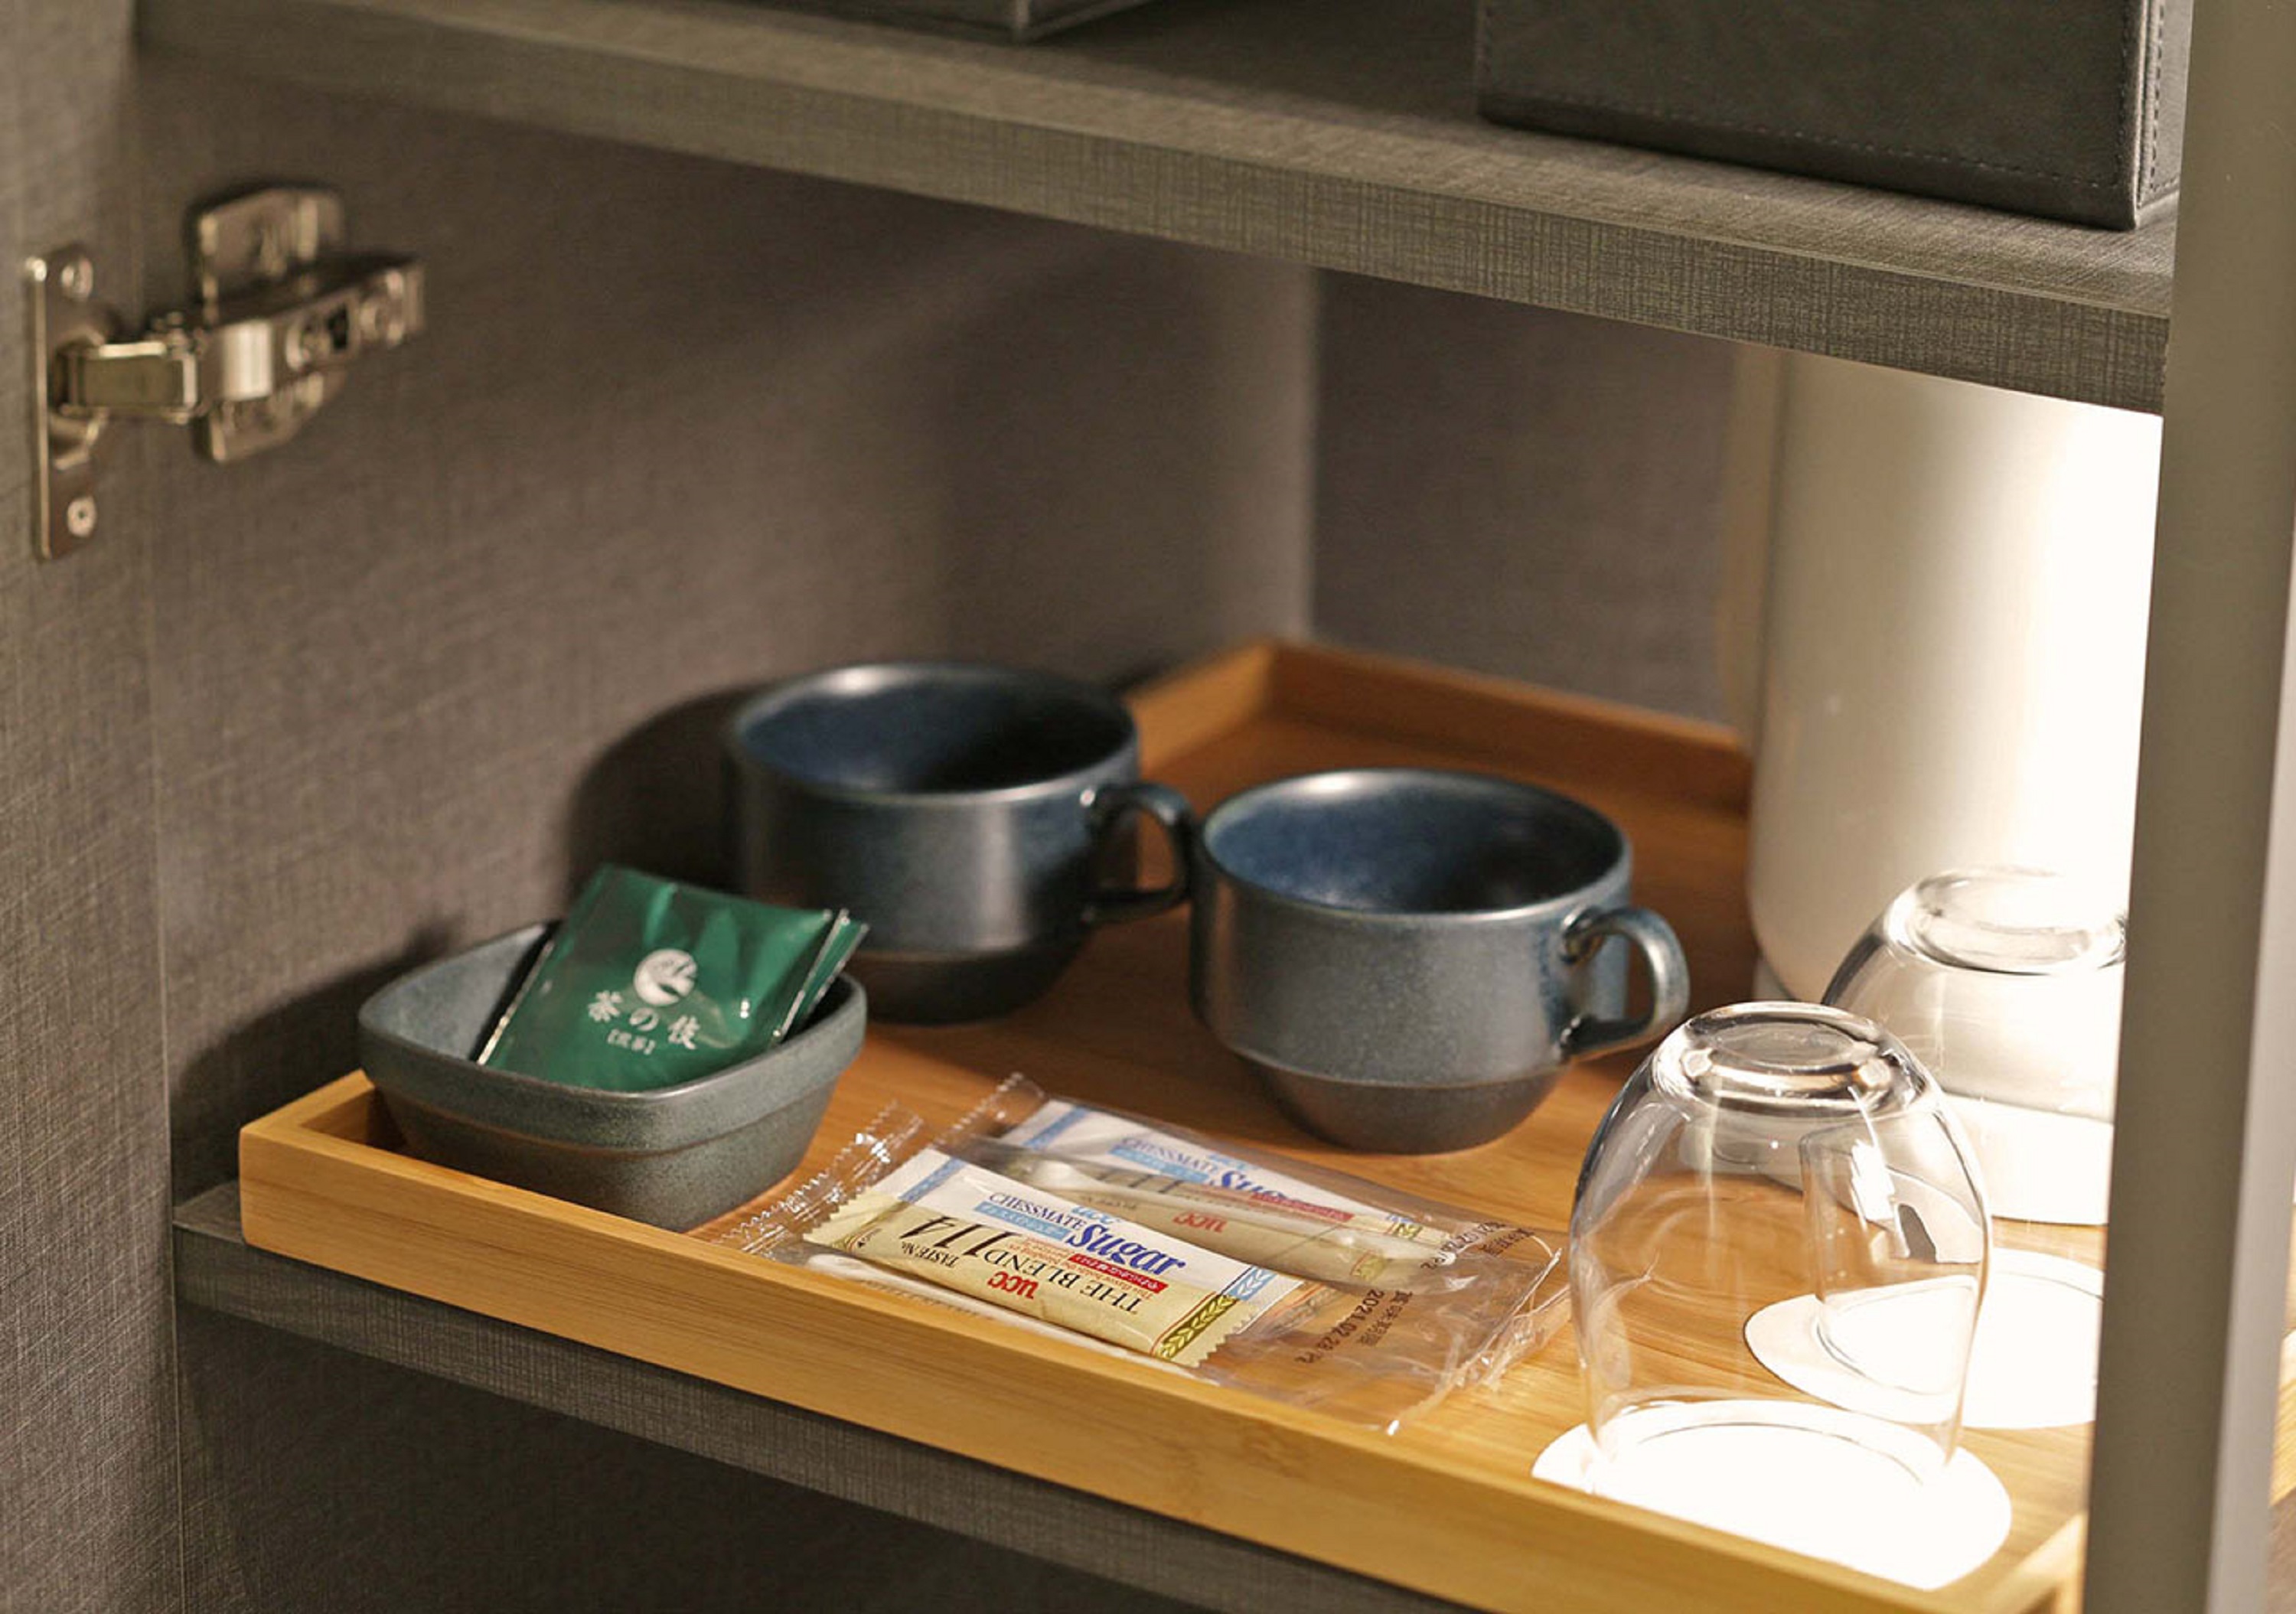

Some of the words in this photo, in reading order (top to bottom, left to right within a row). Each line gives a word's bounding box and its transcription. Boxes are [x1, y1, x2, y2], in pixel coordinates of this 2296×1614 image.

[899, 1216, 1024, 1257] 114
[989, 1192, 1088, 1231] CHESSMATE
[1065, 1224, 1187, 1277] Sugar
[918, 1247, 960, 1269] TASTE
[983, 1248, 1081, 1290] BLEND
[1079, 1283, 1143, 1316] THE
